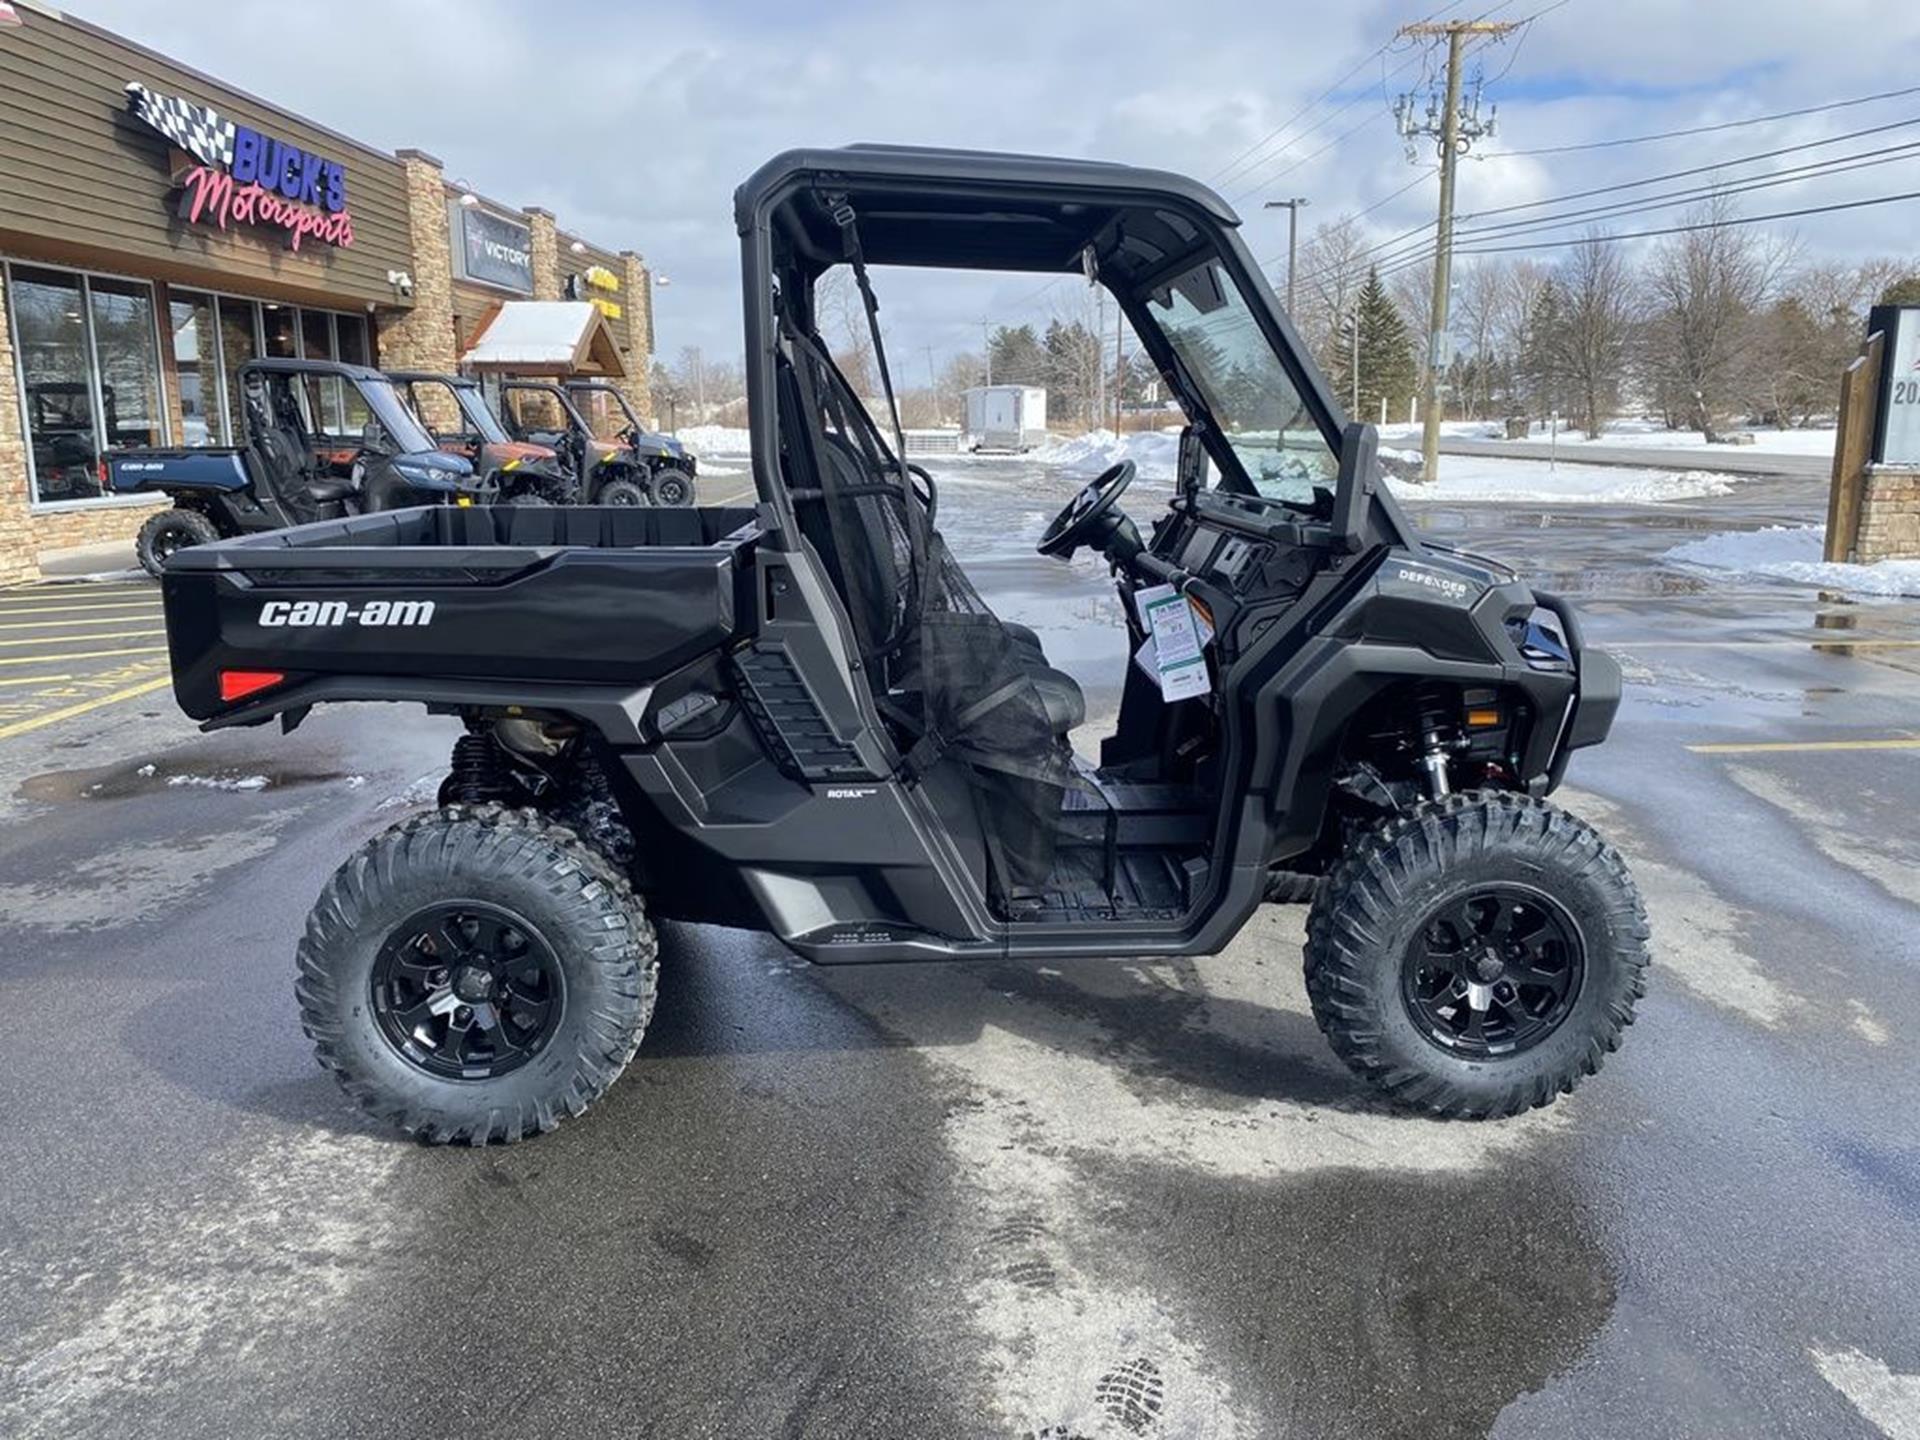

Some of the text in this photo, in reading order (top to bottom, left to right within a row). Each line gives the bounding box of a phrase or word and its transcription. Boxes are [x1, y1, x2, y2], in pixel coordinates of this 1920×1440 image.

[233, 125, 345, 212] BUCK'S
[185, 165, 354, 251] Motorsports
[484, 239, 531, 268] VICTORY
[1893, 380, 1920, 404] 20
[1399, 569, 1467, 593] DEFENDER
[258, 601, 436, 626] can-am
[827, 789, 864, 799] ROTAX
